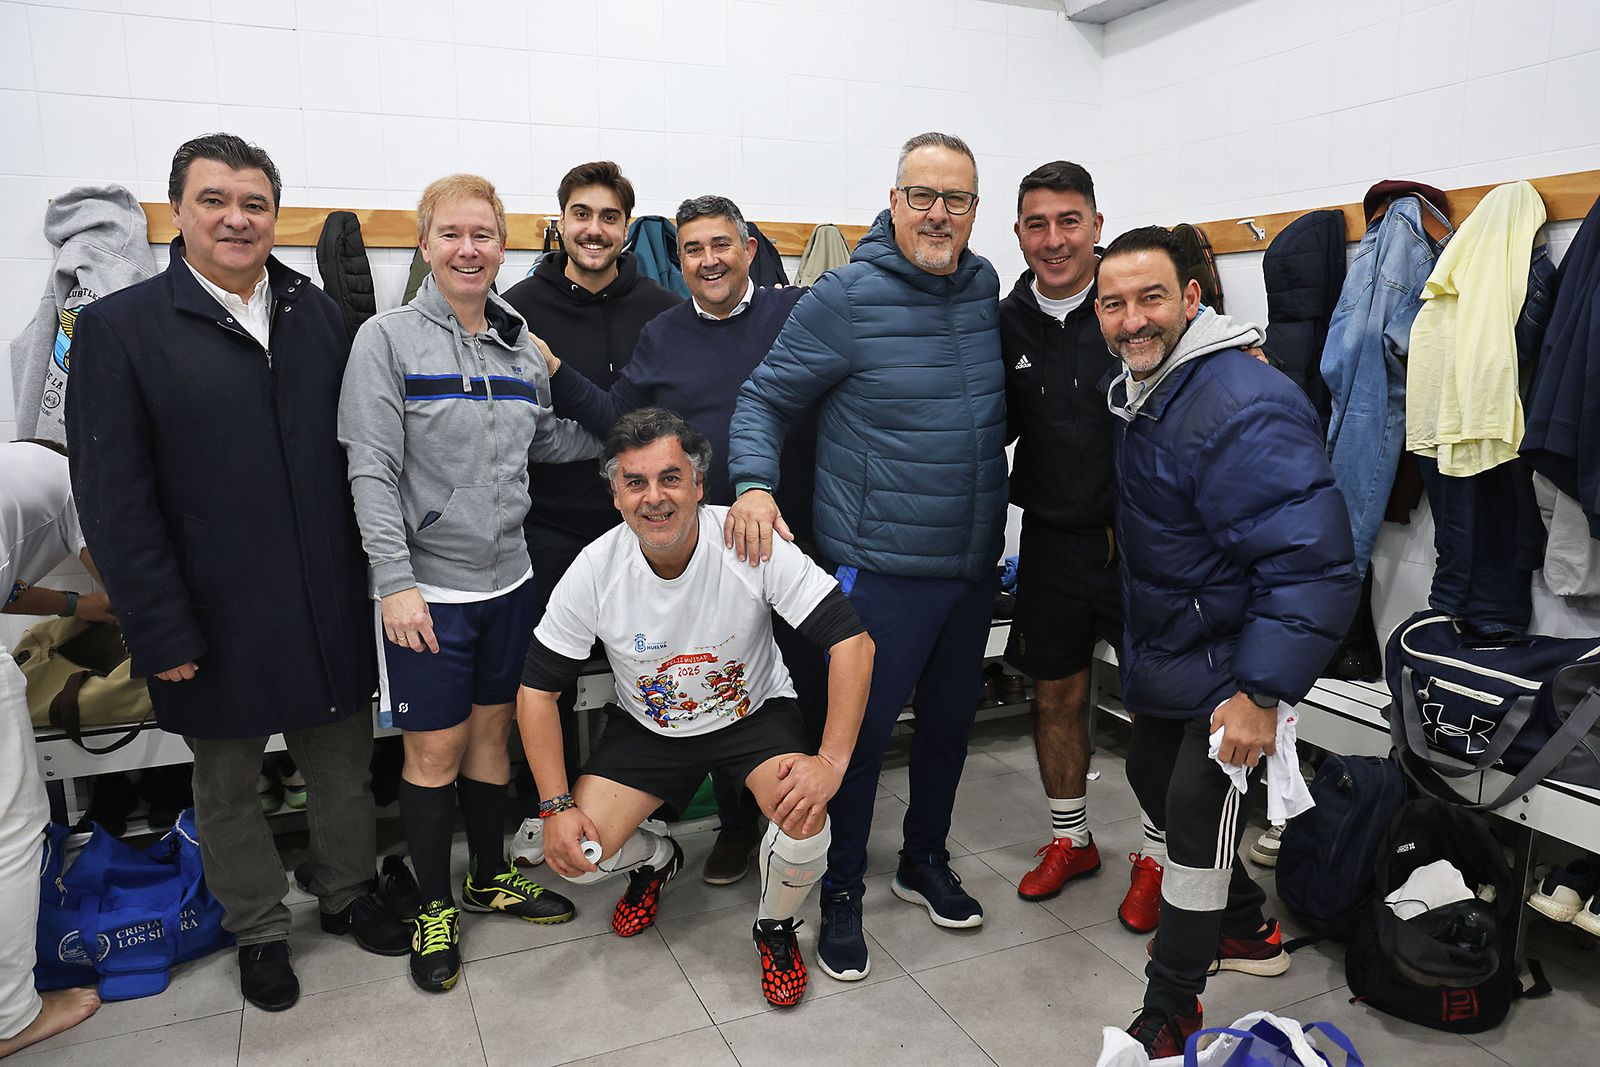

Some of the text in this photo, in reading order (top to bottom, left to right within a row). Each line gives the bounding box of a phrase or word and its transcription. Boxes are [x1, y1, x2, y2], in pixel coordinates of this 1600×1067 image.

[51, 378, 64, 390] LA
[646, 643, 668, 651] HUELVA
[665, 656, 684, 666] FELIZ
[677, 665, 701, 678] 2025
[118, 934, 146, 949] LOS
